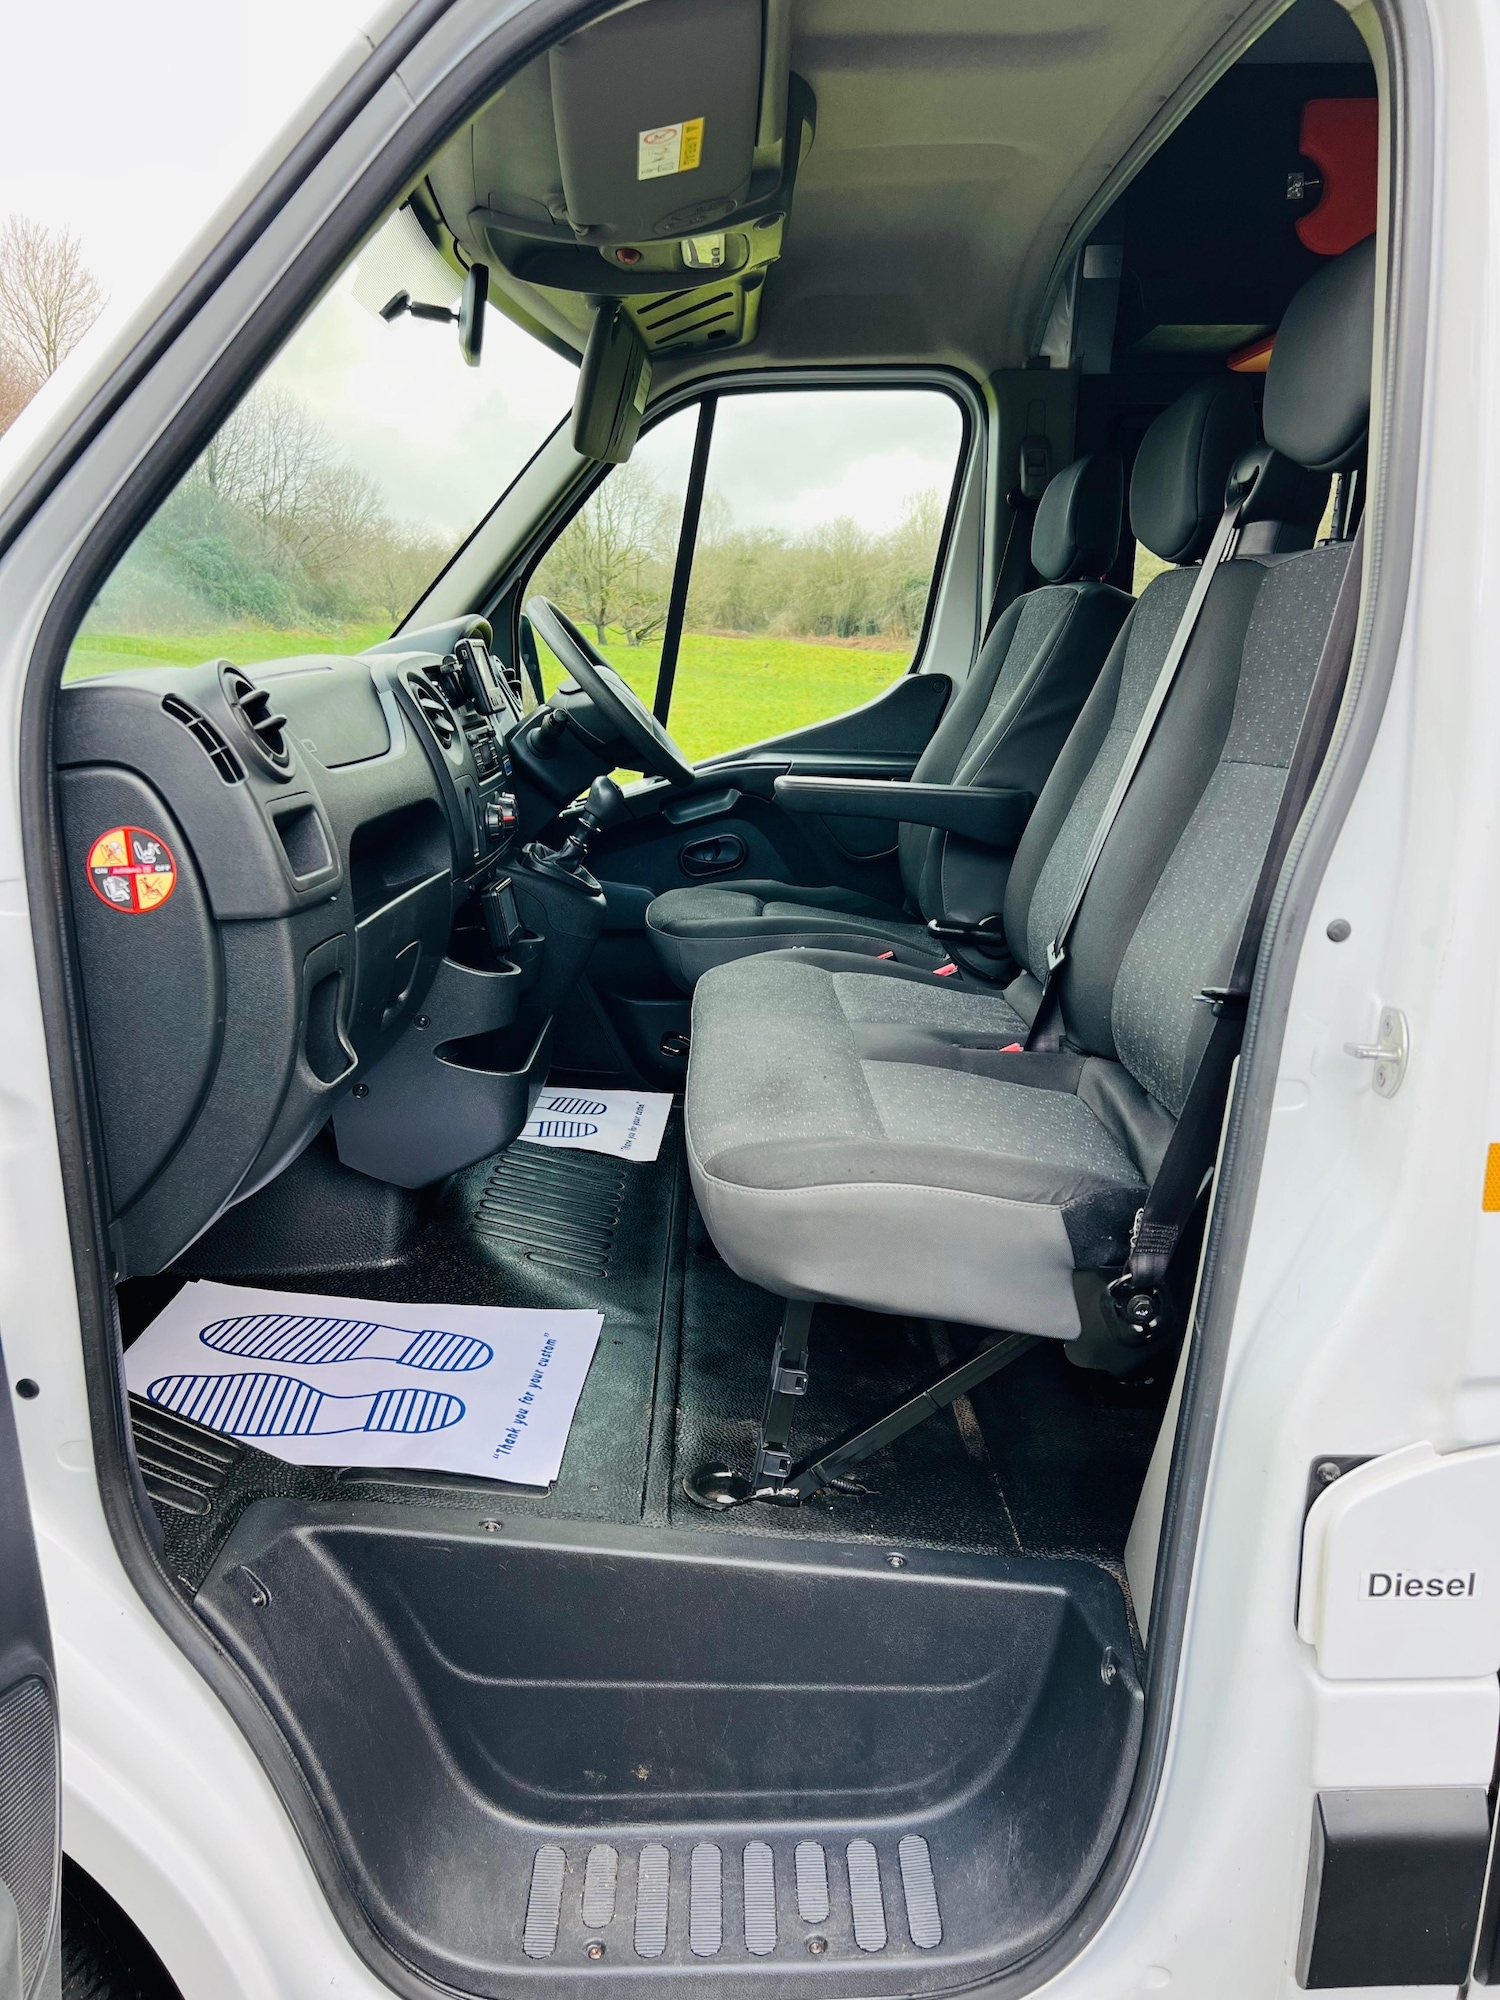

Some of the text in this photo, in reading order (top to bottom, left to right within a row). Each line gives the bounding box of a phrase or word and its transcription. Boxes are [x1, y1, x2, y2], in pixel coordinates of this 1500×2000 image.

[529, 1369, 545, 1389] your
[518, 1392, 535, 1405] for
[514, 1408, 528, 1426] you
[1368, 1573, 1475, 1597] Diesel
